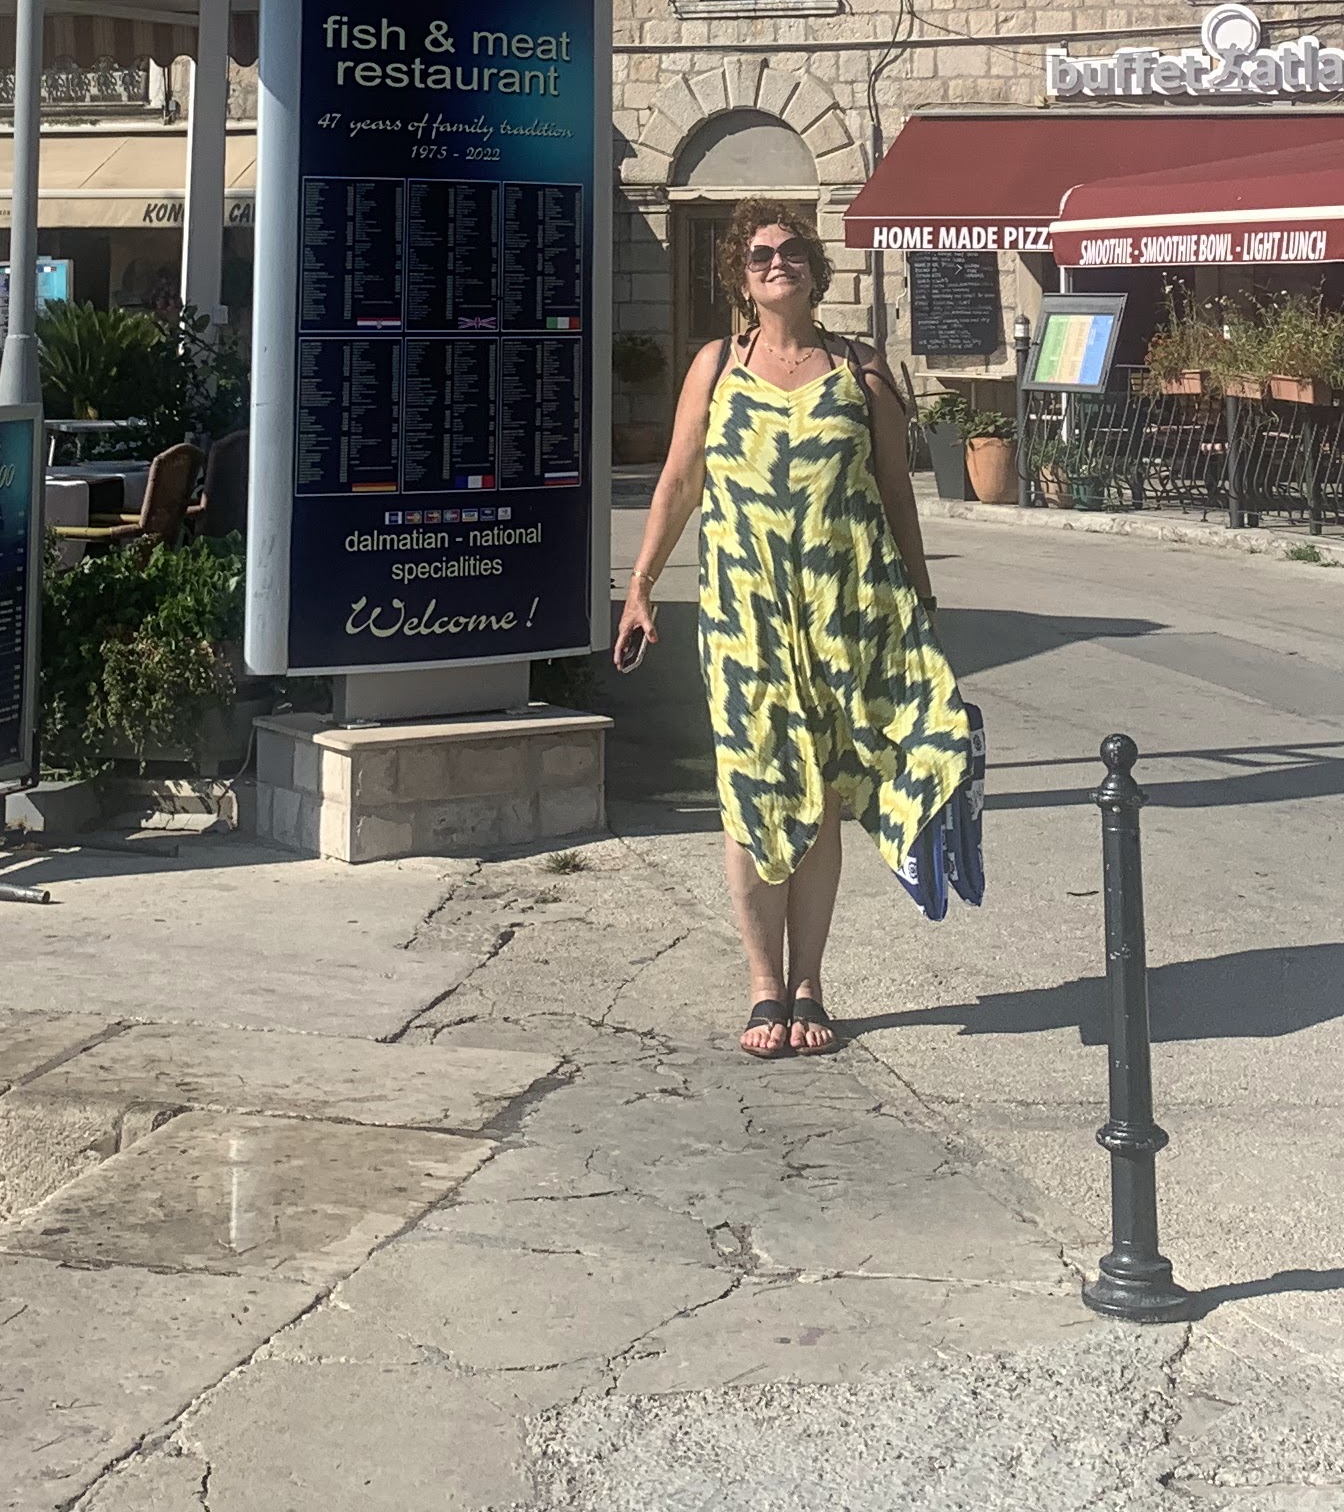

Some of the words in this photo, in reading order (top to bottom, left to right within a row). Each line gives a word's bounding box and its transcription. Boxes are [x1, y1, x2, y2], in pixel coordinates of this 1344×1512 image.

[322, 15, 406, 51] fish
[424, 20, 455, 54] &
[472, 31, 571, 61] meat
[337, 57, 559, 96] restaurant
[1048, 47, 1208, 94] buffet
[317, 112, 341, 129] 47
[350, 118, 402, 138] years
[407, 112, 429, 139] of
[432, 114, 494, 142] family
[500, 118, 575, 139] tradition
[411, 144, 447, 159] 1975
[465, 145, 501, 161] 2022
[873, 226, 933, 250] HOME
[938, 226, 998, 250] MADE
[1004, 226, 1053, 250] PIZZ
[1079, 237, 1132, 265] SMOOTHIE
[1139, 234, 1197, 263] SMOOTHIE
[1198, 233, 1233, 261] BOWL
[1242, 231, 1280, 261] LIGHT
[1281, 230, 1327, 260] LUNCH
[345, 528, 449, 552] dalmatian
[469, 523, 542, 547] national
[391, 555, 503, 584] specialities
[345, 595, 518, 638] Welcome
